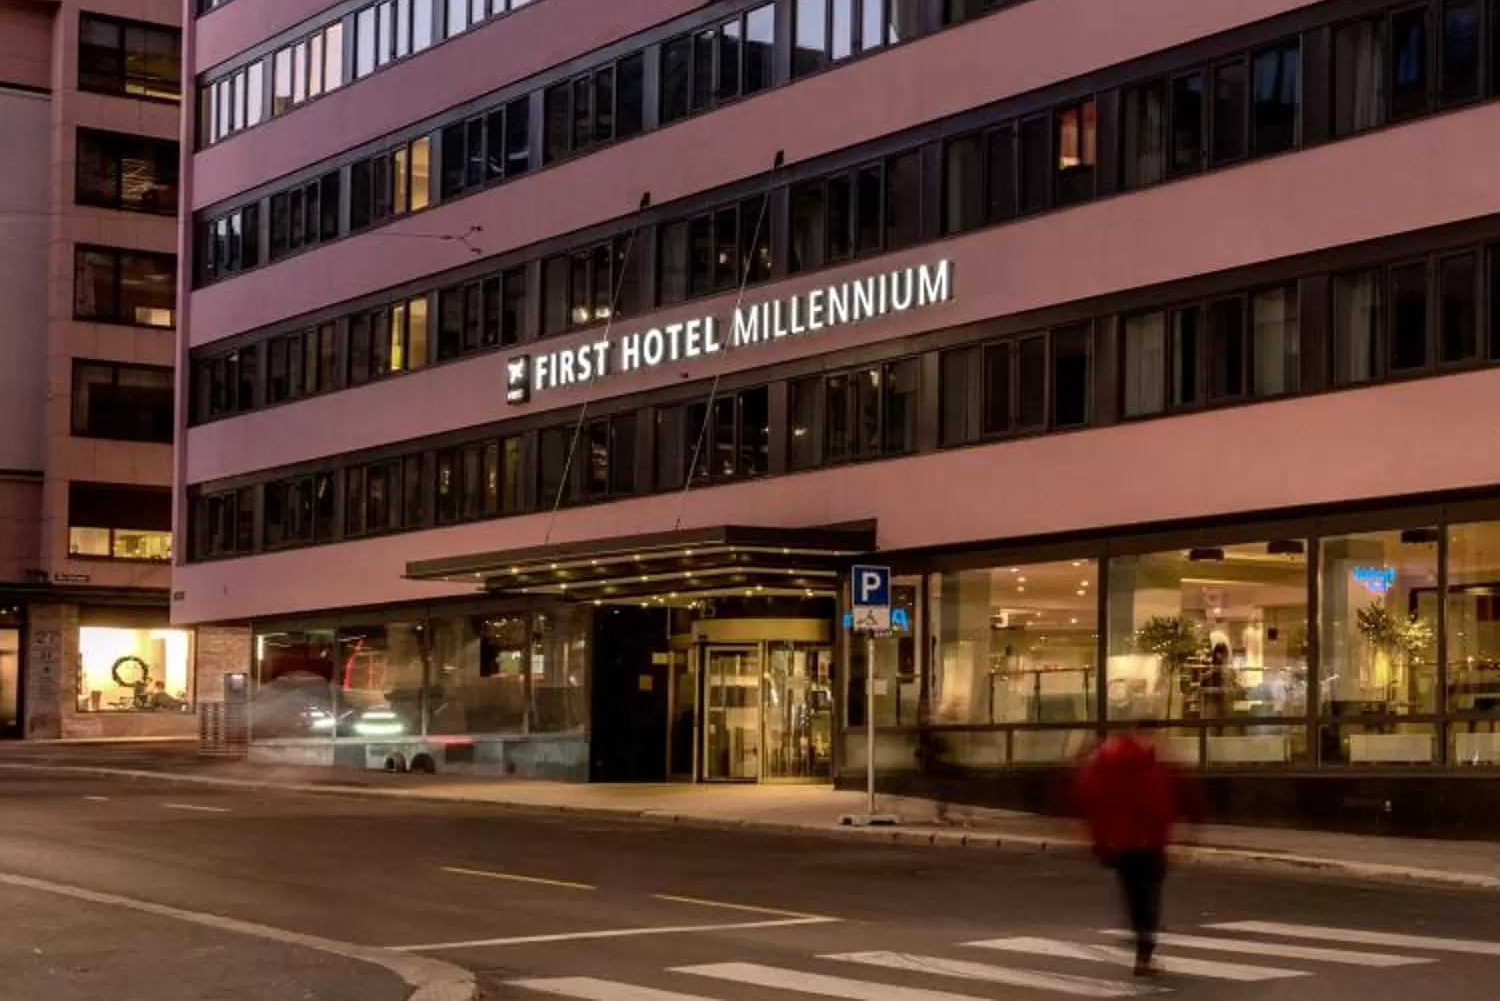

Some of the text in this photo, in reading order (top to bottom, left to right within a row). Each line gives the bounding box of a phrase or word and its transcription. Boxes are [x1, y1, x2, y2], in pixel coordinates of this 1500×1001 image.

[535, 259, 948, 390] FIRST HOTEL MILLENNIUM
[862, 572, 880, 601] P
